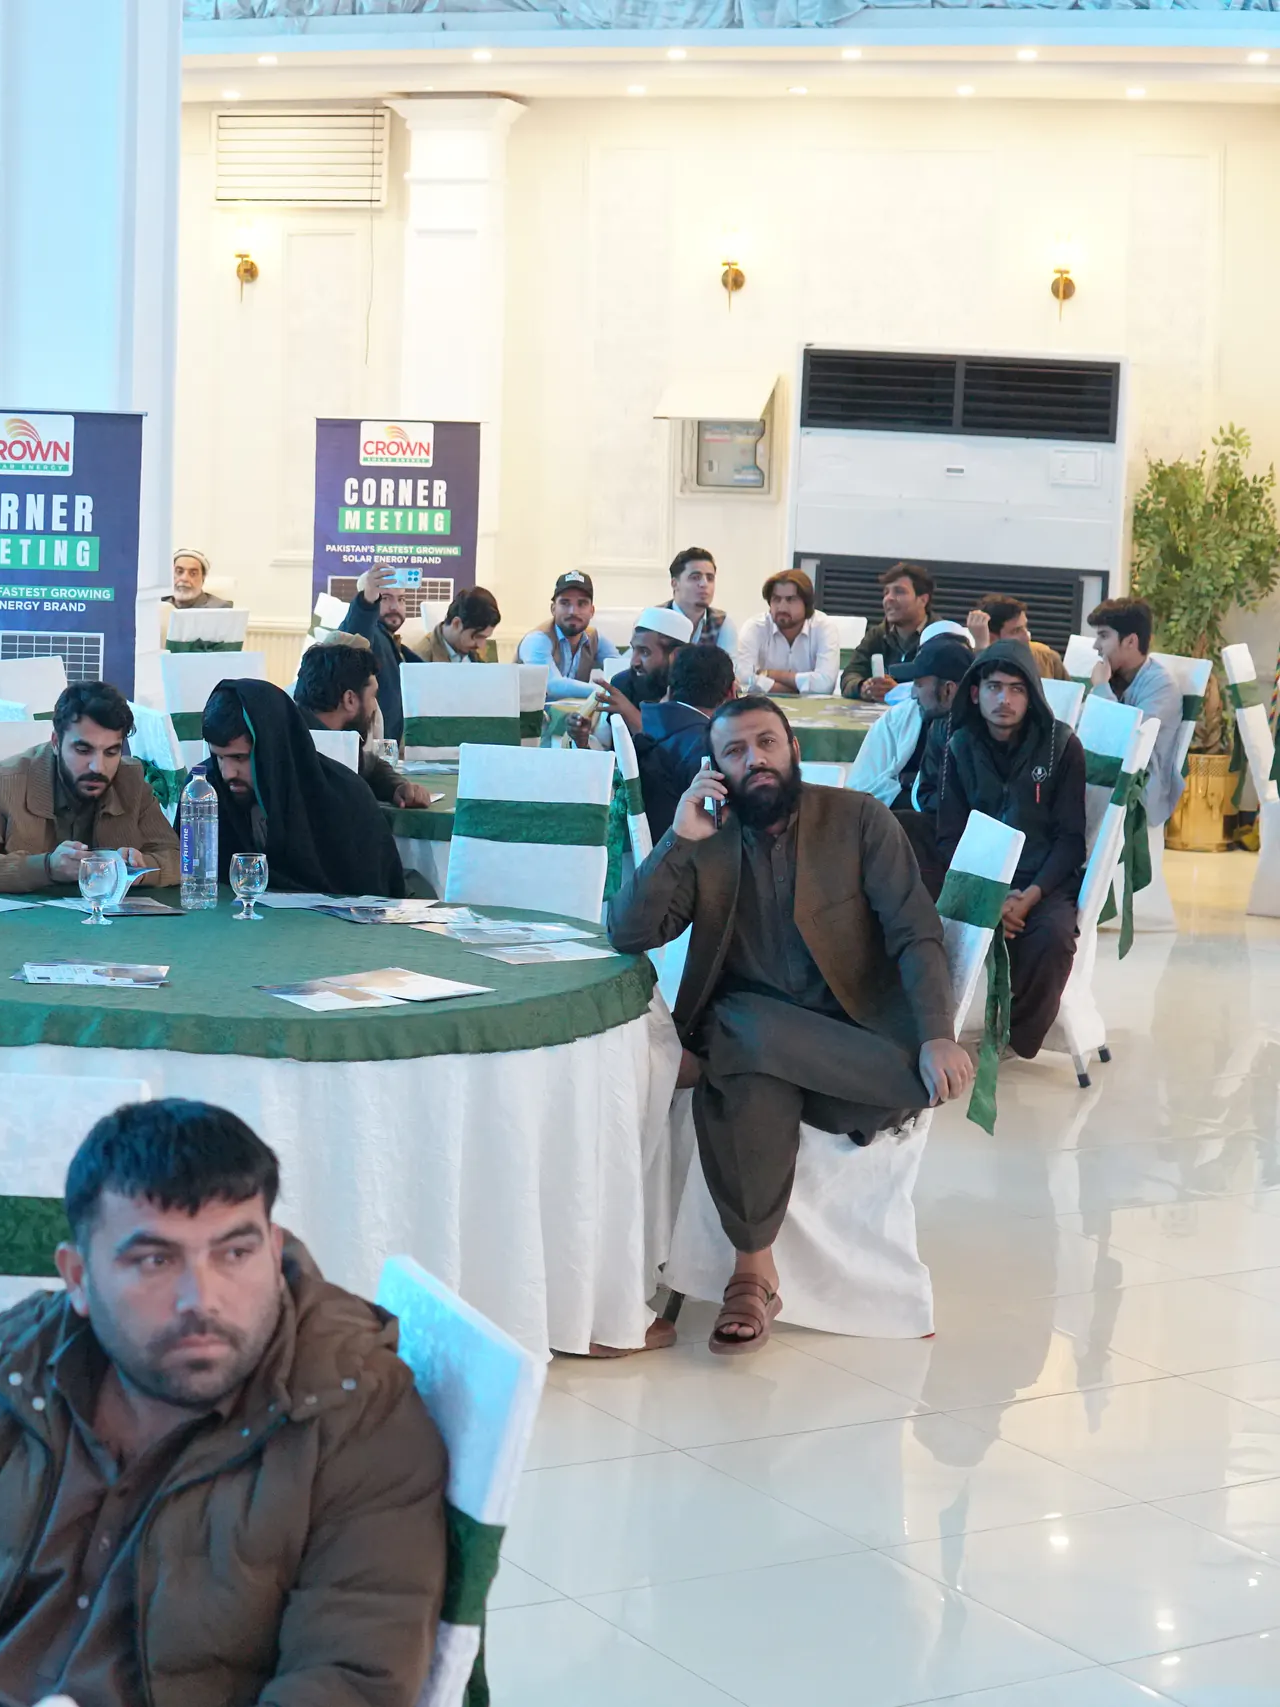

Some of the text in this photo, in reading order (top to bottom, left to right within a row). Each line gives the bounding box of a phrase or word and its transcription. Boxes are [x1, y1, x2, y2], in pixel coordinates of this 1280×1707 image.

[363, 440, 430, 457] CROWN
[344, 477, 447, 507] CORNER
[345, 510, 445, 532] MEETING
[325, 544, 458, 554] PAKISTAN'S FASTEST GROWING
[342, 554, 442, 564] SOLAR ENERGY BRAND
[50, 587, 111, 599] GROWING
[43, 601, 86, 612] BRAND
